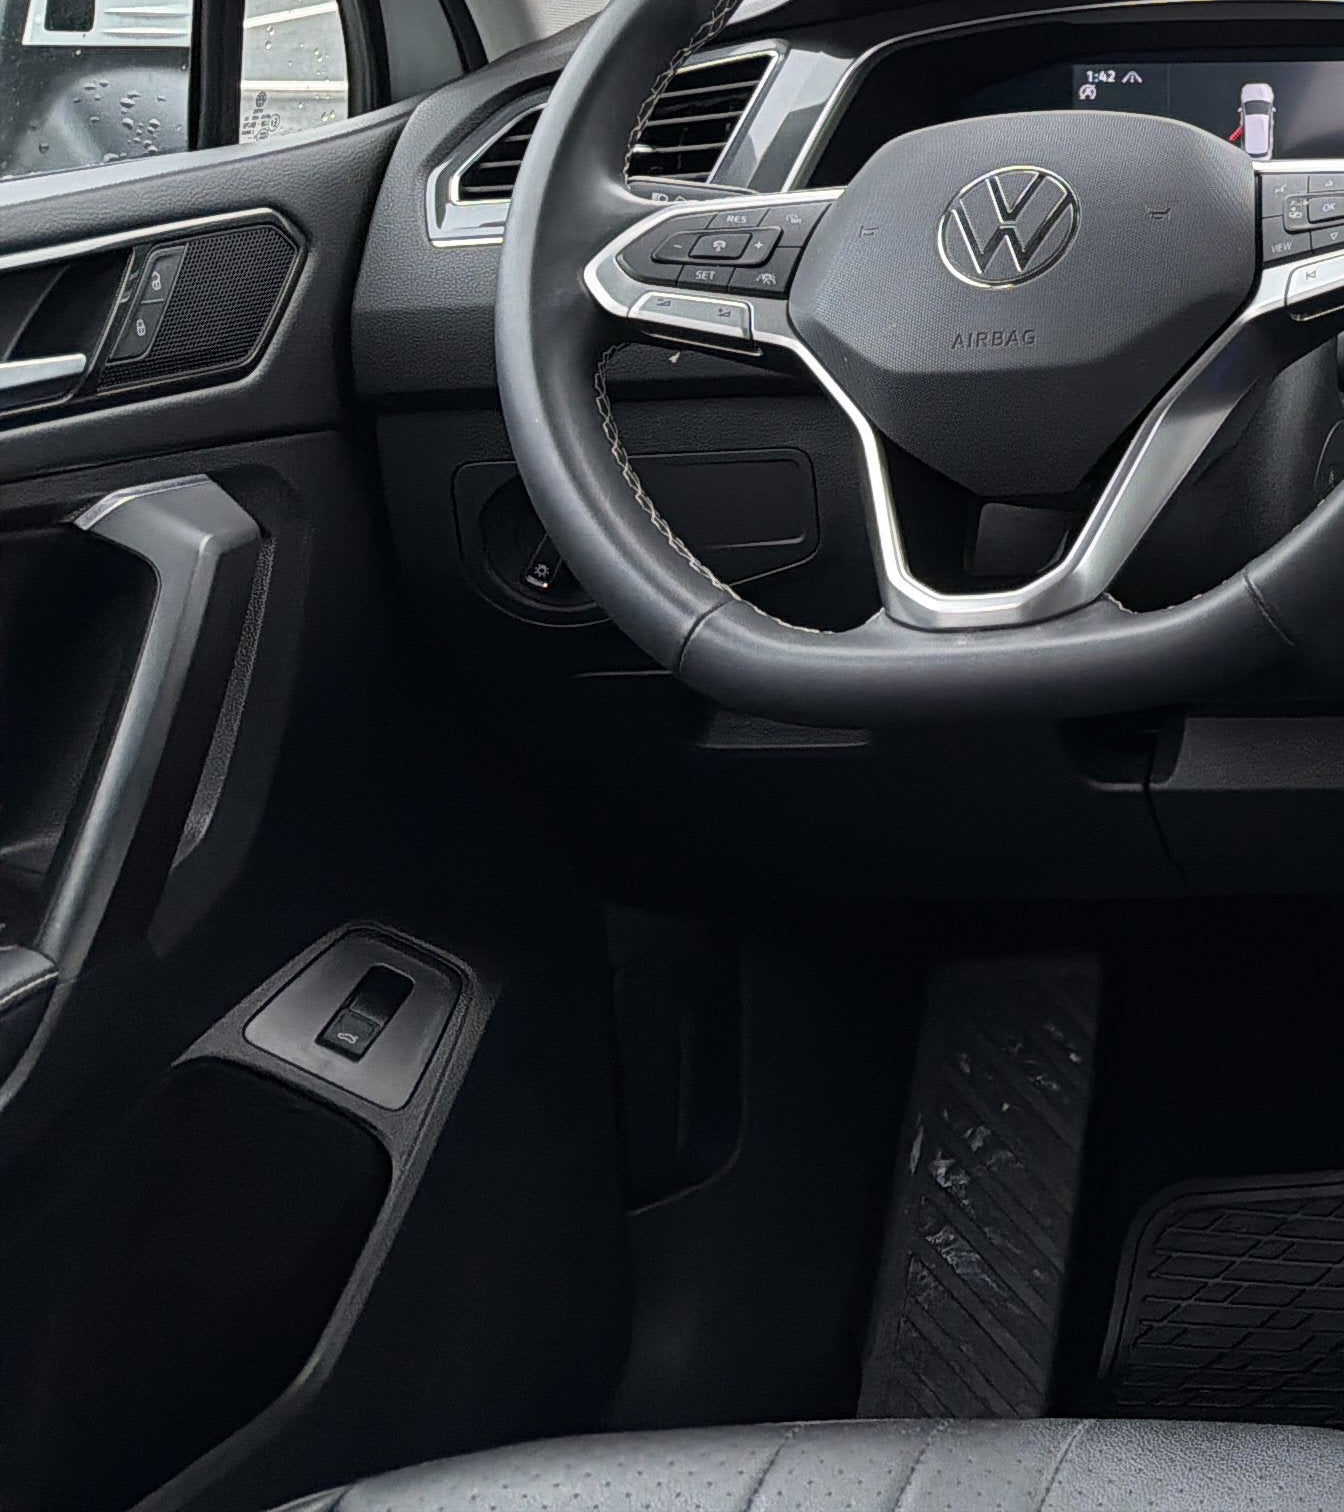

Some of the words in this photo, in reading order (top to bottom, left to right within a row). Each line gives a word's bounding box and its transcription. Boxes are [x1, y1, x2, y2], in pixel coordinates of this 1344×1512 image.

[1086, 70, 1116, 83] 1:42
[1321, 201, 1336, 212] OK
[726, 215, 748, 224] RES
[1270, 241, 1293, 253] VIEW
[695, 270, 717, 281] SET
[951, 329, 1037, 351] AIRBAG
